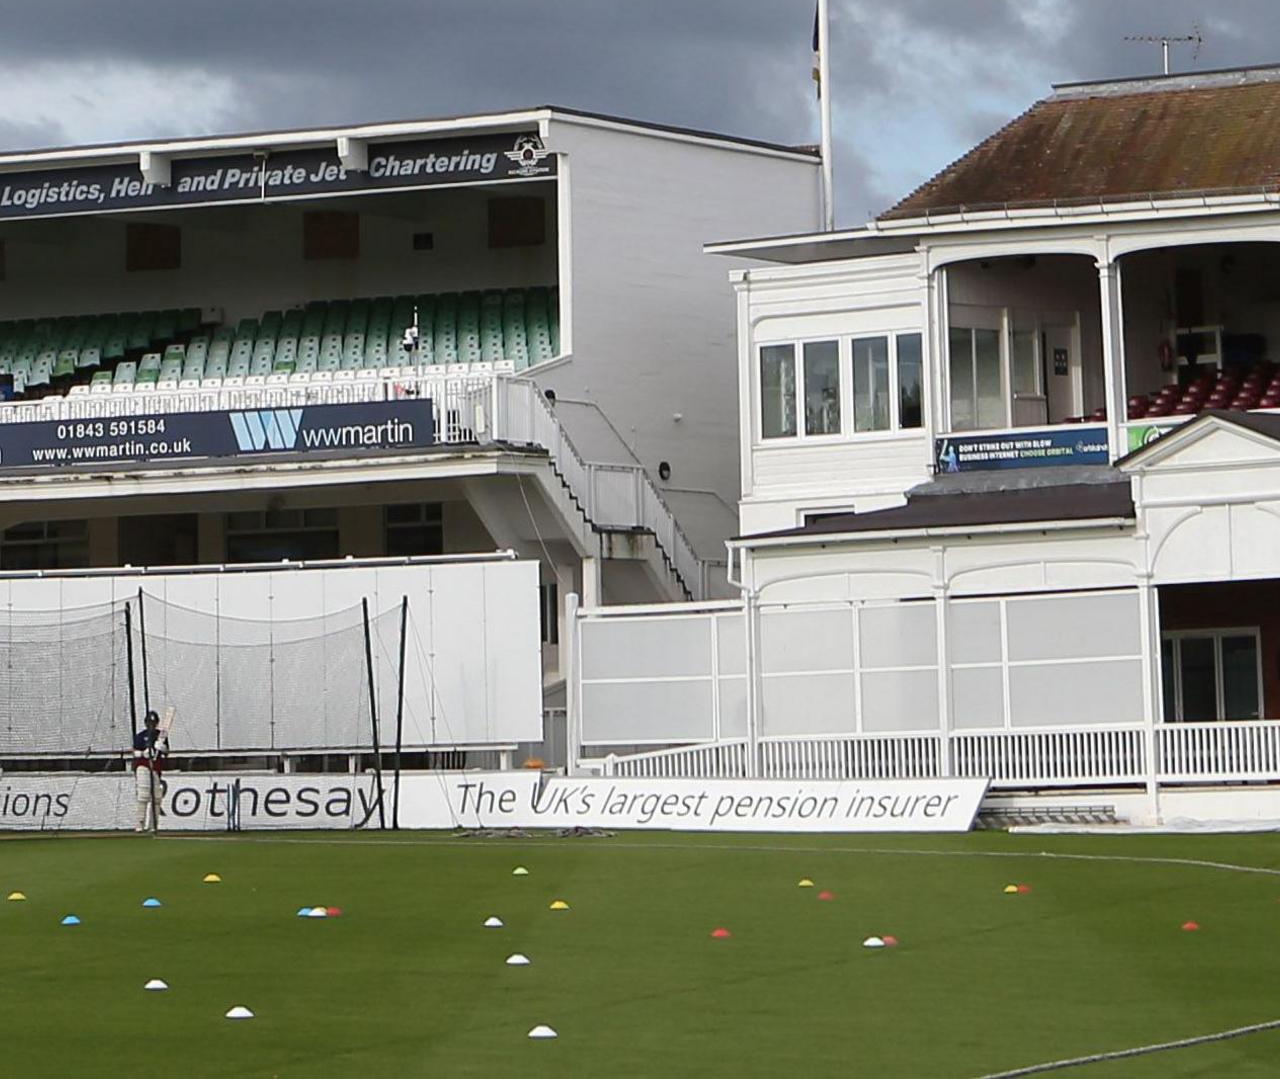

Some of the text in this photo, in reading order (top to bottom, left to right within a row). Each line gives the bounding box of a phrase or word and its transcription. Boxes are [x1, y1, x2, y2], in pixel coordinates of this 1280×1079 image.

[0, 182, 105, 209] Logistics,
[177, 168, 223, 193] and
[223, 165, 306, 190] Private
[310, 161, 347, 182] Jet
[369, 150, 498, 178] Chartering
[57, 419, 166, 439] 01843 591584
[302, 418, 413, 447] wwmartin
[32, 437, 192, 461] www.wwmartin.co.uk
[158, 778, 386, 829] othesay
[457, 781, 517, 814] The
[601, 785, 708, 824] largest
[710, 789, 839, 826] pension
[845, 788, 959, 818] insurer
